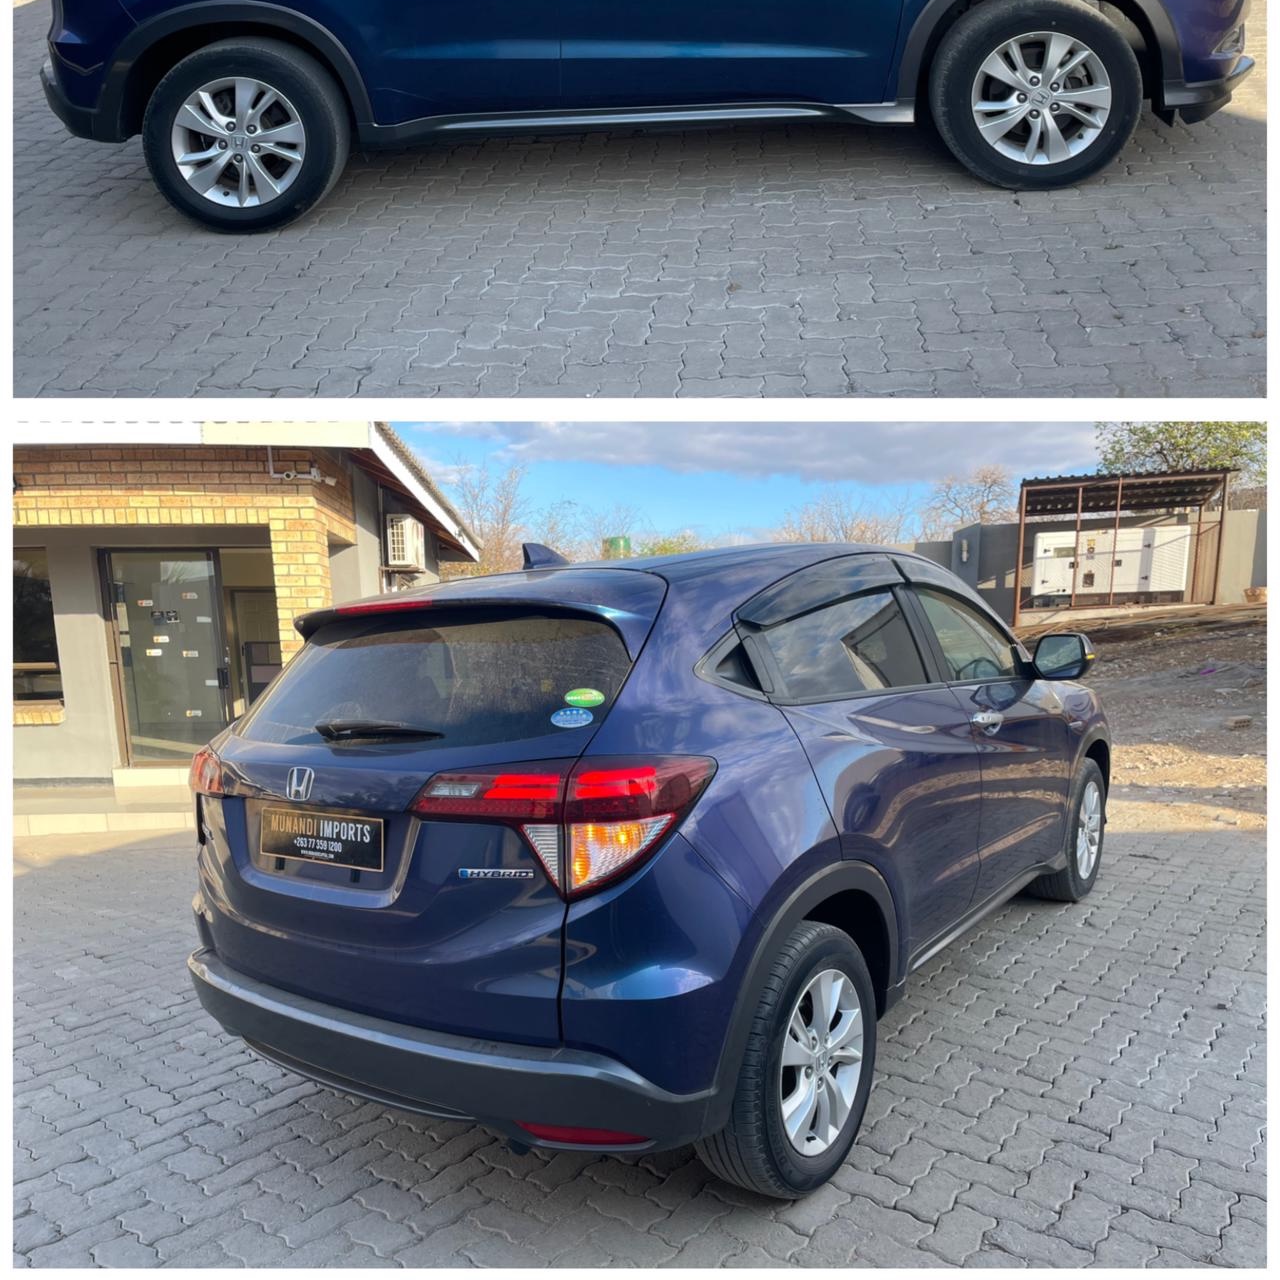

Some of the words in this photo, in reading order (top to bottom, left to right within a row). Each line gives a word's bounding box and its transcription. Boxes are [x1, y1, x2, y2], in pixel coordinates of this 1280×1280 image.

[271, 814, 318, 836] MUNANDI
[320, 819, 371, 843] IMPORTS
[294, 837, 308, 848] +263
[308, 839, 315, 849] 77
[316, 840, 328, 850] 359
[328, 841, 342, 853] 1200
[469, 870, 529, 878] HYBRID
